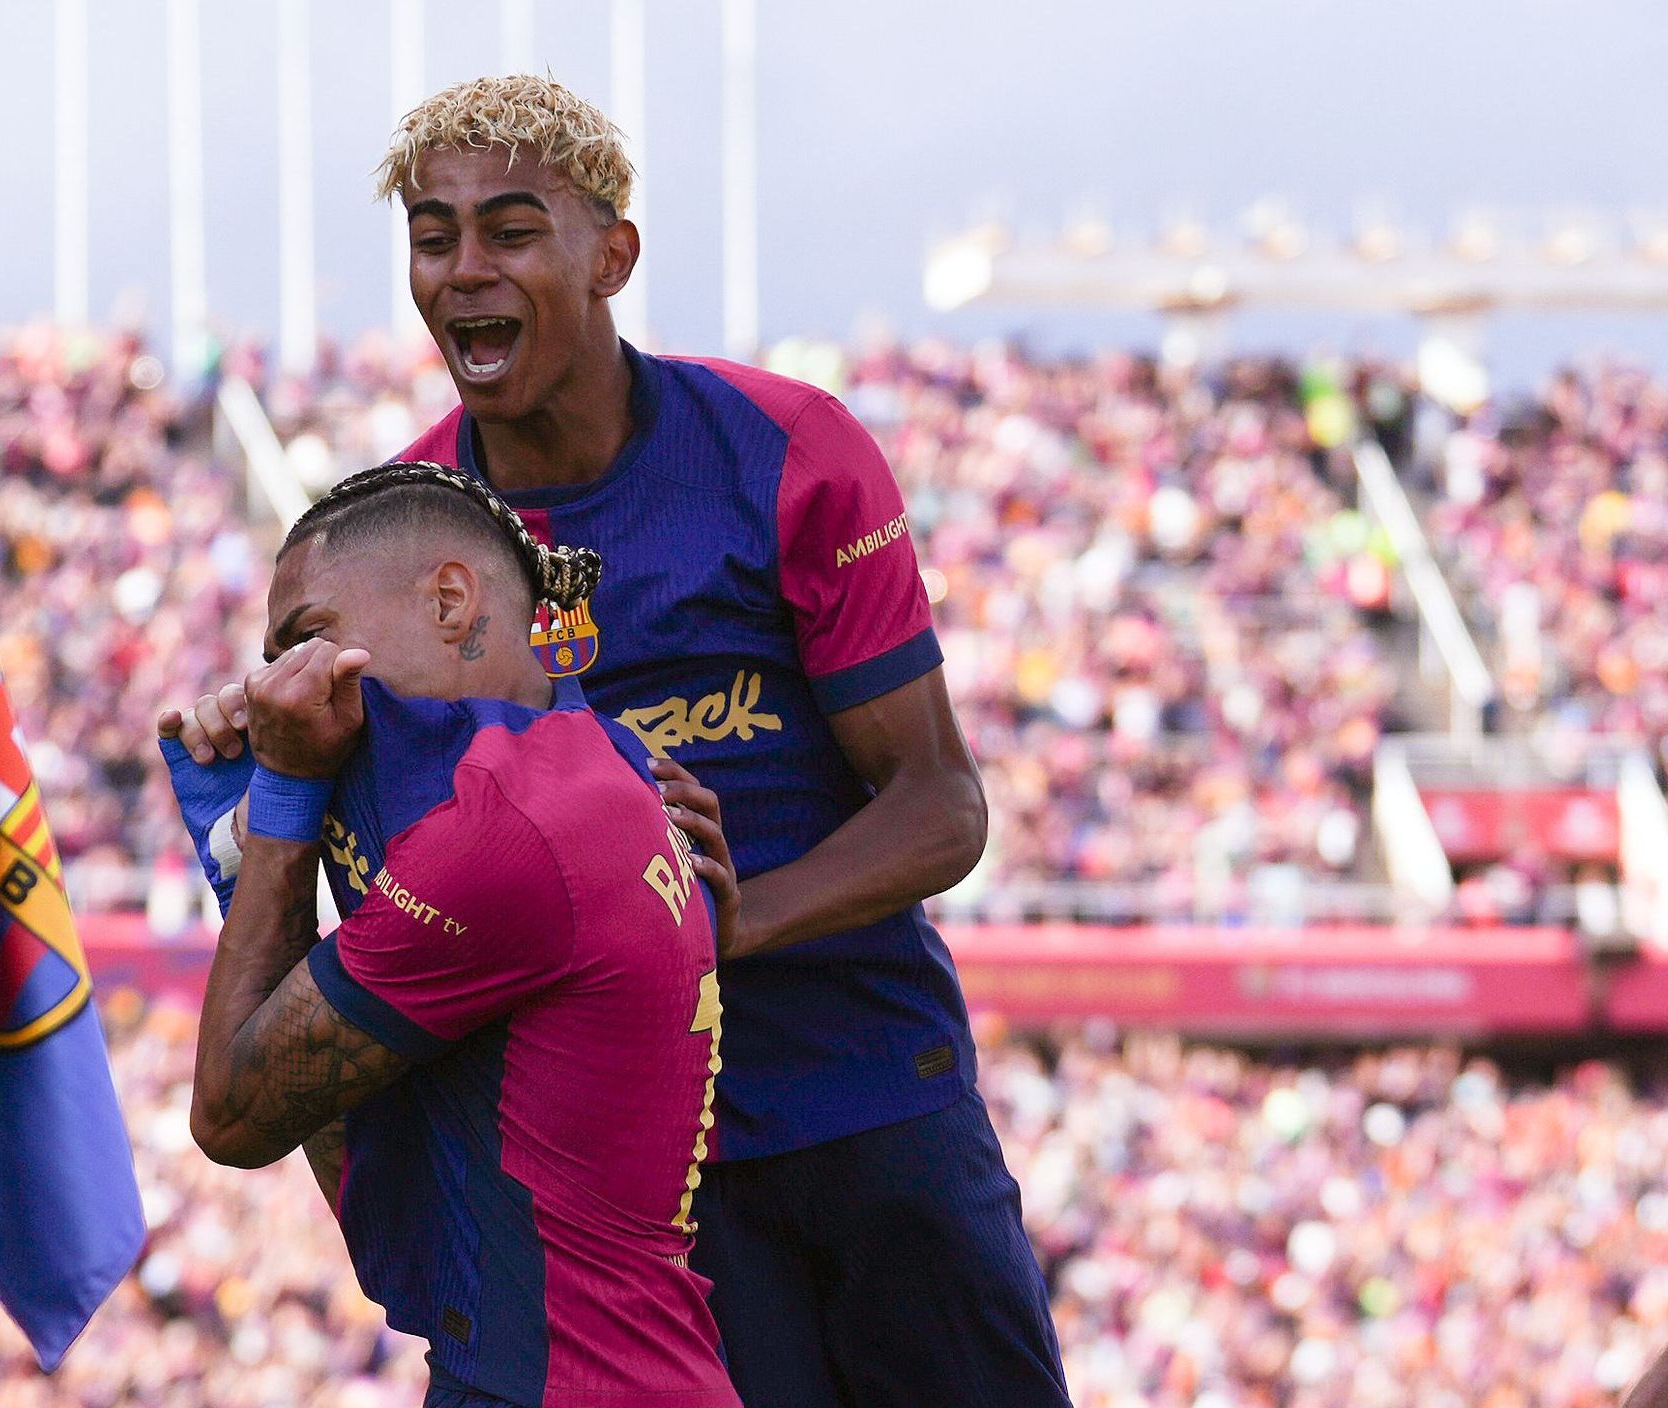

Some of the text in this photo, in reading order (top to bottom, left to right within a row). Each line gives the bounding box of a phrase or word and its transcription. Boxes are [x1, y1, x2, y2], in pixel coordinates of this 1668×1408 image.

[835, 511, 909, 568] AMBILIGHT
[546, 628, 575, 642] FCB
[443, 916, 468, 936] tv
